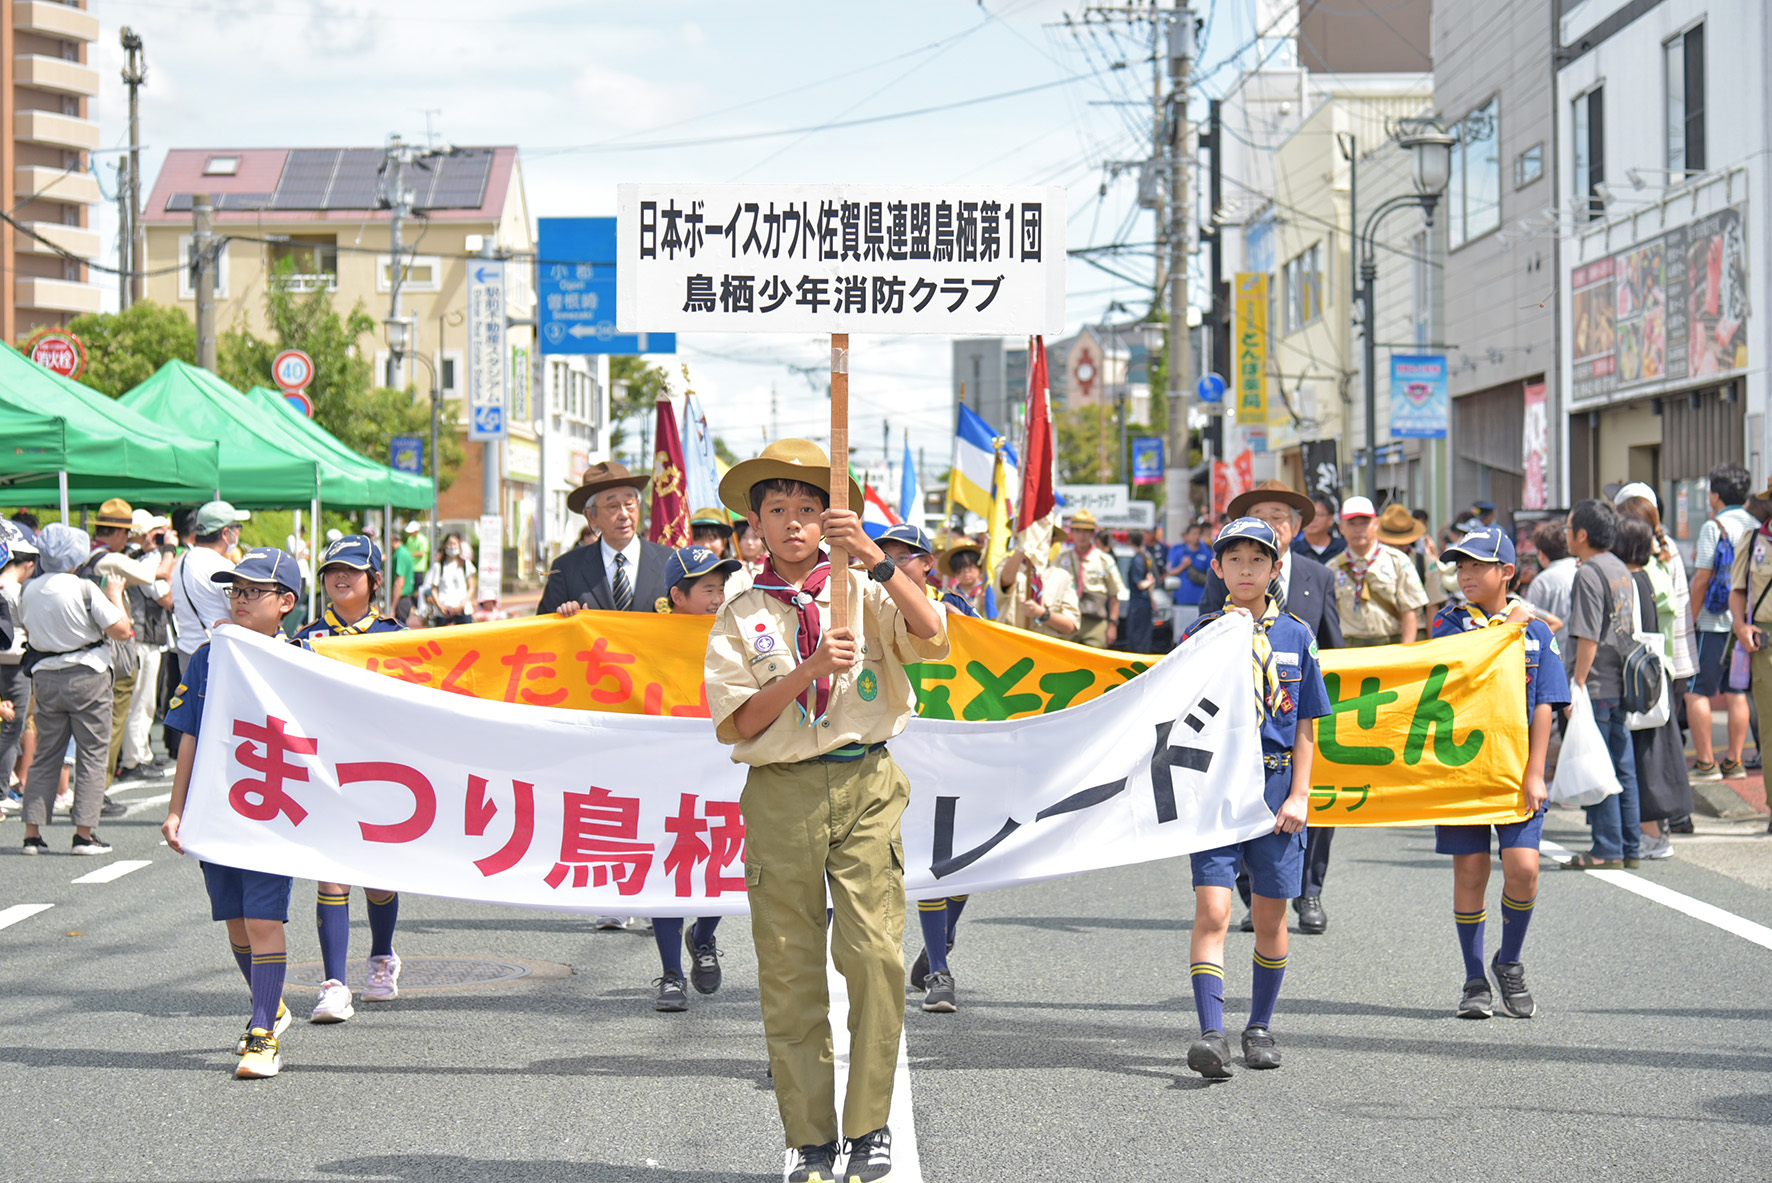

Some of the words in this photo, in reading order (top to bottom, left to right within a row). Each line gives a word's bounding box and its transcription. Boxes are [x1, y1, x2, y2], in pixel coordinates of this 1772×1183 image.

[639, 198, 1043, 263] 日本ボーイスカウト佐賀県連盟鳥栖第1団
[682, 272, 1006, 315] 鳥栖少年消防クラブ
[36, 350, 73, 370] 消火栓
[283, 362, 304, 380] 40
